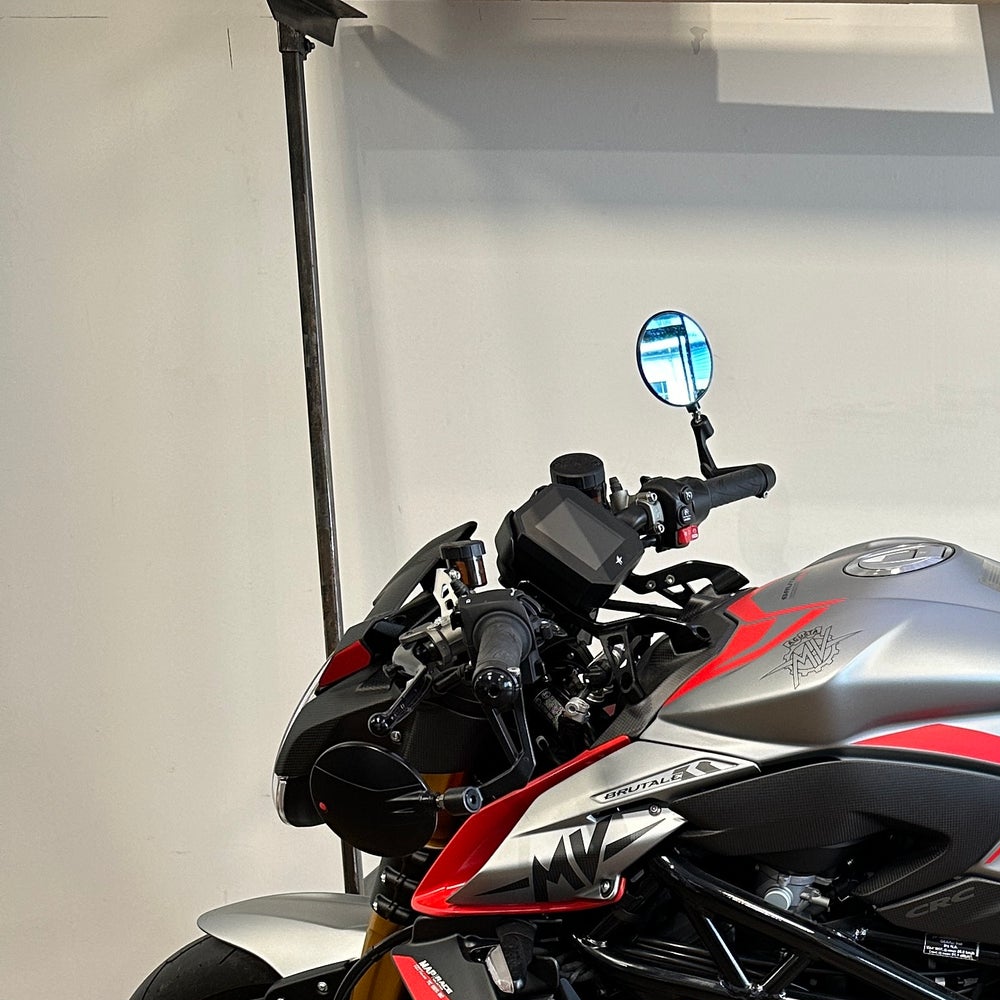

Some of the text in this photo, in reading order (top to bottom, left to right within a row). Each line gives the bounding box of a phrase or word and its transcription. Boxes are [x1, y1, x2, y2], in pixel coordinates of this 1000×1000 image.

[604, 772, 684, 800] BRUTALE
[531, 813, 613, 902] MV
[905, 887, 975, 919] CRC
